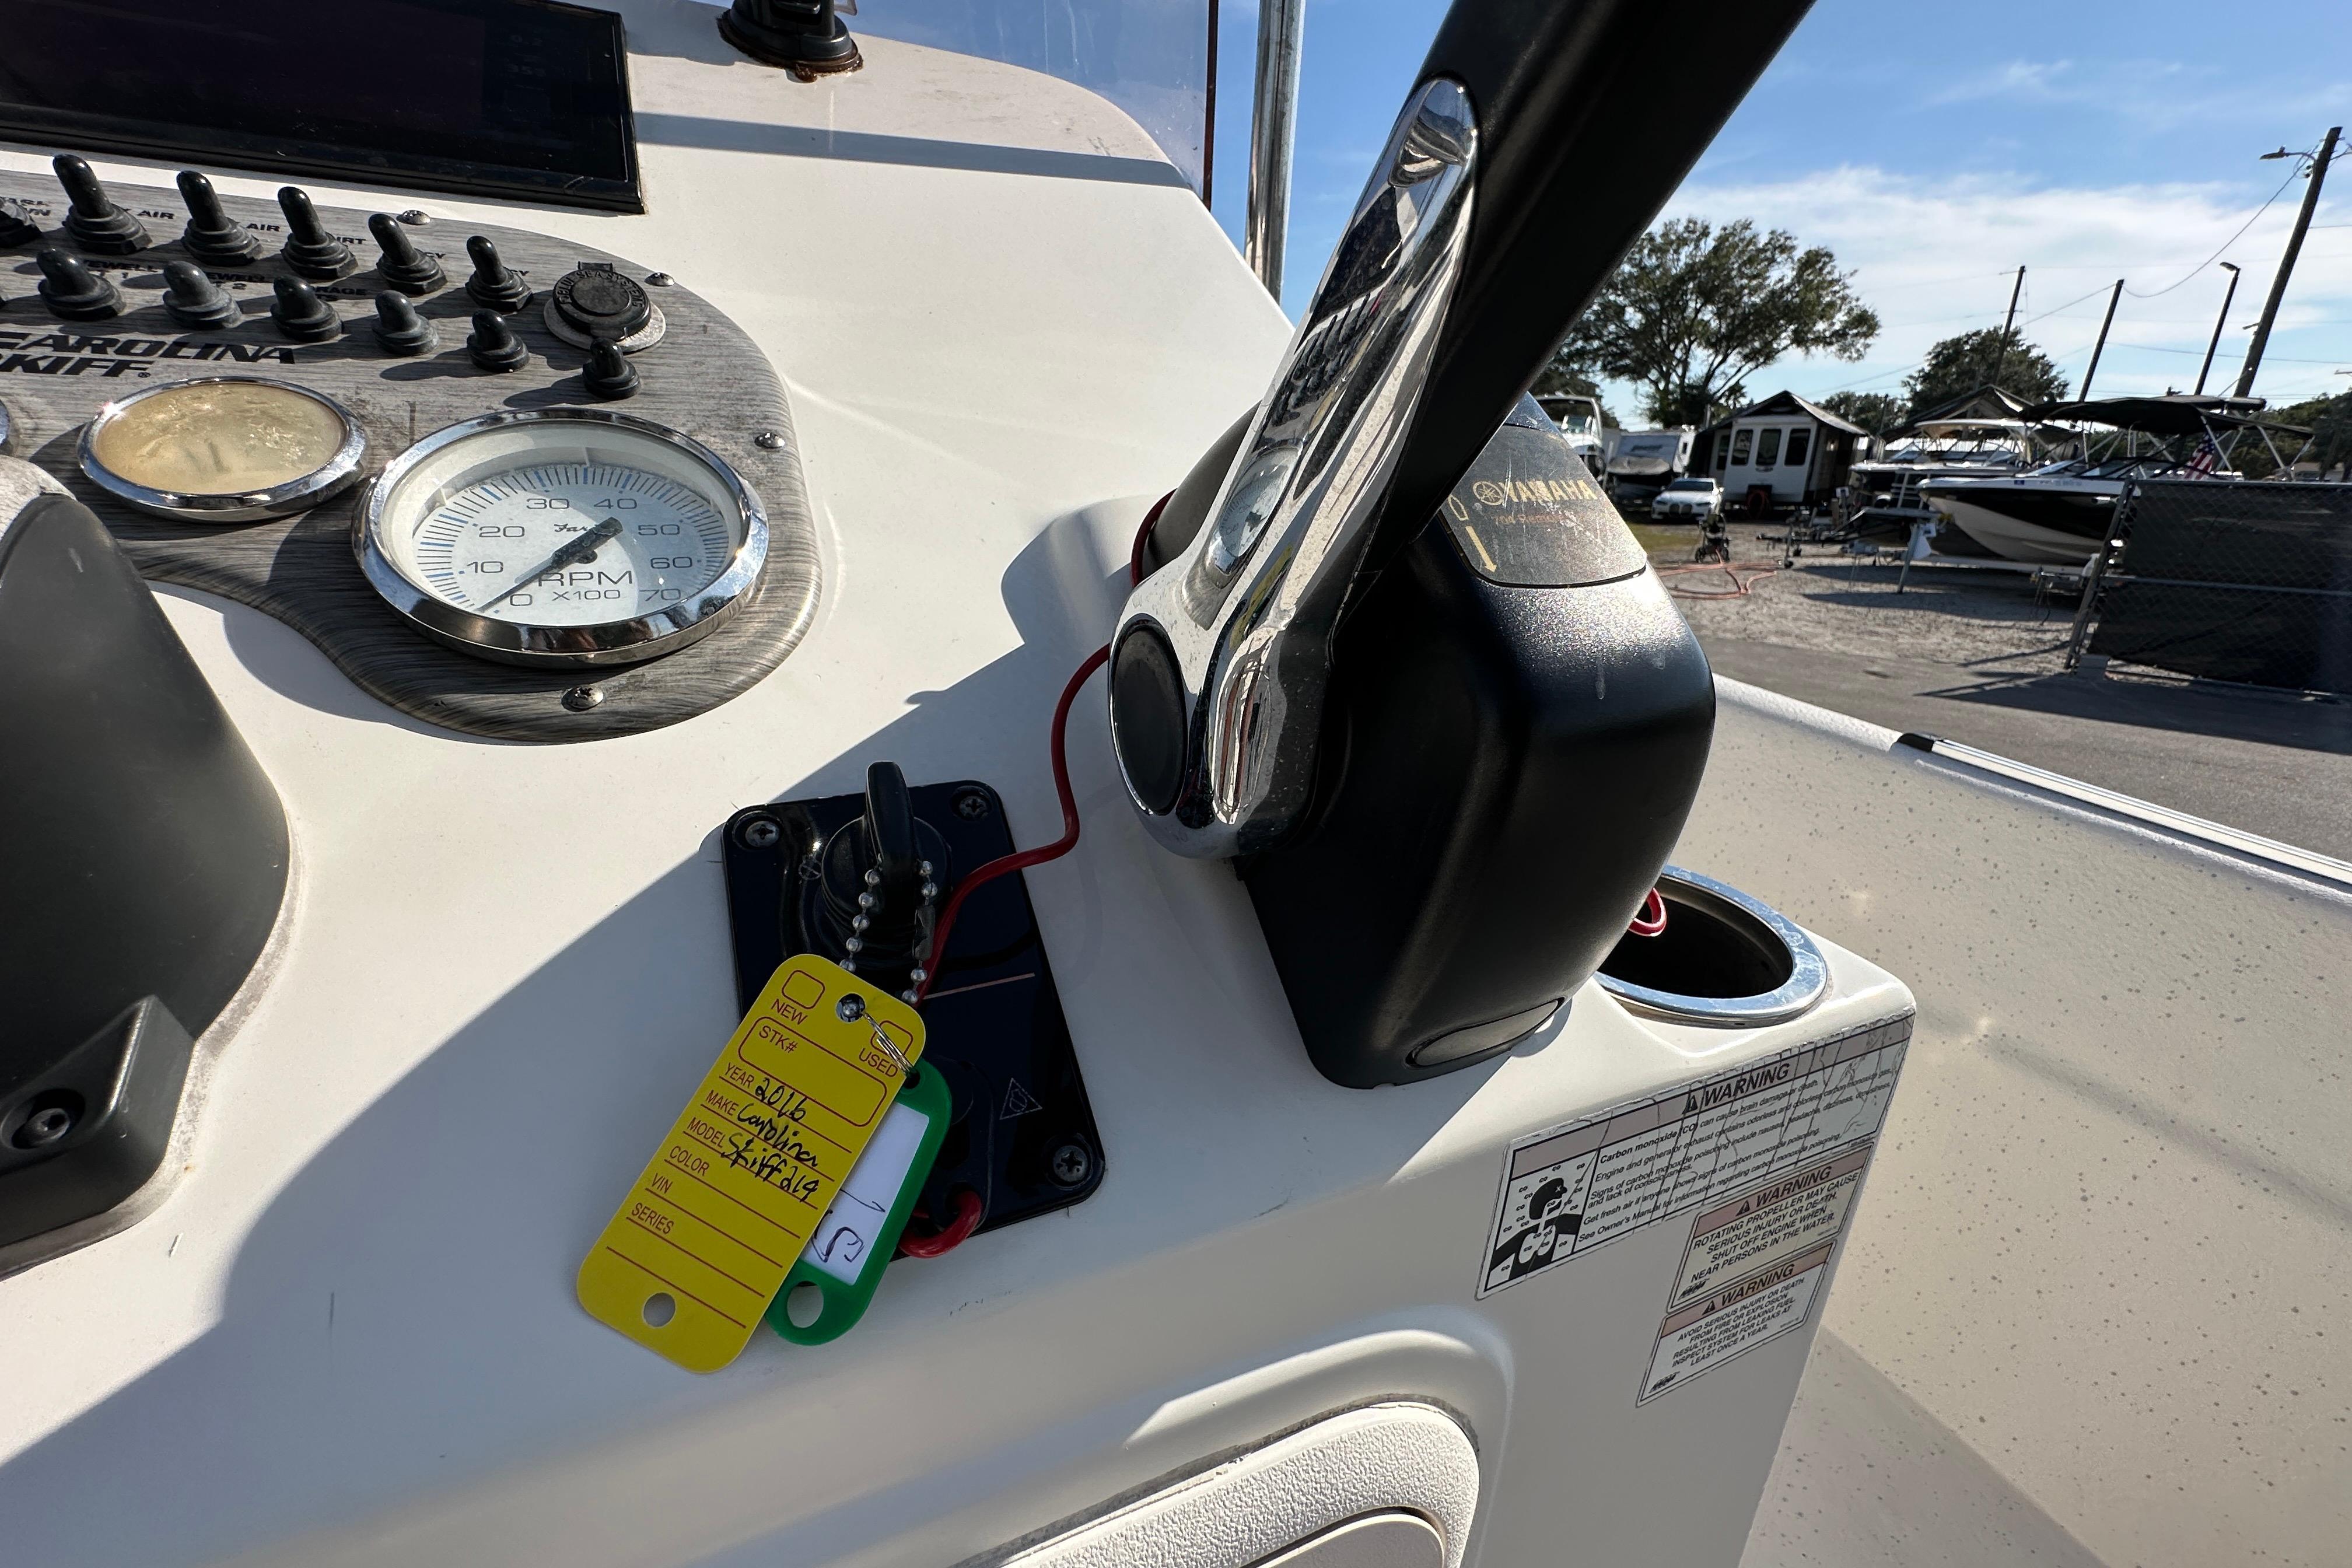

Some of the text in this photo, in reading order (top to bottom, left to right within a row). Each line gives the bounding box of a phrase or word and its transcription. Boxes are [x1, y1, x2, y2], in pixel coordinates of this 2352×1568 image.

[137, 210, 174, 219] AIR
[246, 223, 281, 232] AIR
[576, 270, 603, 279] SEA
[0, 352, 155, 377] KIFF
[526, 498, 638, 510] 30 40
[1497, 480, 1597, 503] YAMAHA
[479, 526, 525, 538] 20
[638, 524, 680, 536] 50
[466, 556, 693, 573] 10 60
[538, 570, 633, 587] RPM
[510, 588, 681, 607] 0 X100 70
[771, 998, 808, 1025] NEW
[759, 1025, 798, 1054] STK#
[724, 1062, 755, 1088] YEAR
[859, 1048, 898, 1078] USED
[755, 1077, 807, 1121] 2016
[1704, 1063, 1790, 1106] WARNING
[706, 1090, 739, 1116] MAKE
[687, 1117, 727, 1149] MODEL
[737, 1103, 818, 1167] Carolina
[1600, 1147, 1633, 1164] Carbon
[1634, 1131, 1677, 1152] monoxide
[1700, 1118, 1714, 1128] can
[1716, 1109, 1738, 1122] cause
[1740, 1101, 1758, 1114] brain
[670, 1146, 710, 1177] COLOR
[721, 1132, 788, 1181] Skiff
[1595, 1166, 1625, 1182] Engine
[1626, 1157, 1643, 1171] and
[1643, 1144, 1682, 1166] generator
[651, 1172, 673, 1194] VIN
[1583, 1213, 1599, 1225] Get
[1600, 1205, 1621, 1219] fresh
[1622, 1200, 1634, 1210] air
[1718, 1162, 1727, 1172] of
[1727, 1154, 1752, 1168] carbon
[1590, 1186, 1614, 1200] Signs
[1615, 1180, 1625, 1190] of
[1626, 1169, 1654, 1186] carbon
[1655, 1156, 1693, 1175] monoxide
[1756, 1166, 1832, 1208] WARNING
[1588, 1196, 1604, 1209] and
[1605, 1189, 1623, 1202] lack
[1624, 1184, 1633, 1195] of
[1693, 1172, 1859, 1250] ROTATING PROPELLER MAY CAUSE
[631, 1202, 674, 1234] SERIES
[1578, 1231, 1595, 1242] See
[1597, 1216, 1630, 1234] Owner's
[1632, 1203, 1661, 1220] Manual
[1706, 1228, 1751, 1254] SERIOUS
[1752, 1212, 1788, 1234] INJURY
[1789, 1205, 1804, 1218] OR
[1710, 1243, 1739, 1263] SHUT
[1740, 1234, 1760, 1250] OFF
[1760, 1218, 1797, 1240] ENGINE
[1799, 1205, 1827, 1224] WHEN
[1690, 1263, 1720, 1283] NEAR
[1721, 1241, 1768, 1269] PERSONS
[1769, 1236, 1780, 1247] IN
[1782, 1226, 1801, 1241] THE
[1803, 1212, 1834, 1232] WATER.
[1721, 1264, 1794, 1306] WARNING
[1677, 1277, 1805, 1342] AVOID SERIOUS INJURY OR DEATH
[1689, 1292, 1788, 1343] FROM FIRE OR EXPLOSION
[1672, 1346, 1706, 1367] INSPECT
[1707, 1330, 1738, 1350] SYSTEM
[1739, 1322, 1755, 1335] FOR
[1756, 1310, 1781, 1326] LEAKS
[1782, 1304, 1791, 1314] AT
[1673, 1333, 1717, 1359] RESULTING
[1718, 1321, 1741, 1338] FROM
[1741, 1306, 1774, 1326] LEAKING
[1690, 1349, 1716, 1366] LEAST
[1717, 1338, 1738, 1353] ONCE
[1748, 1324, 1768, 1338] YEAR.
